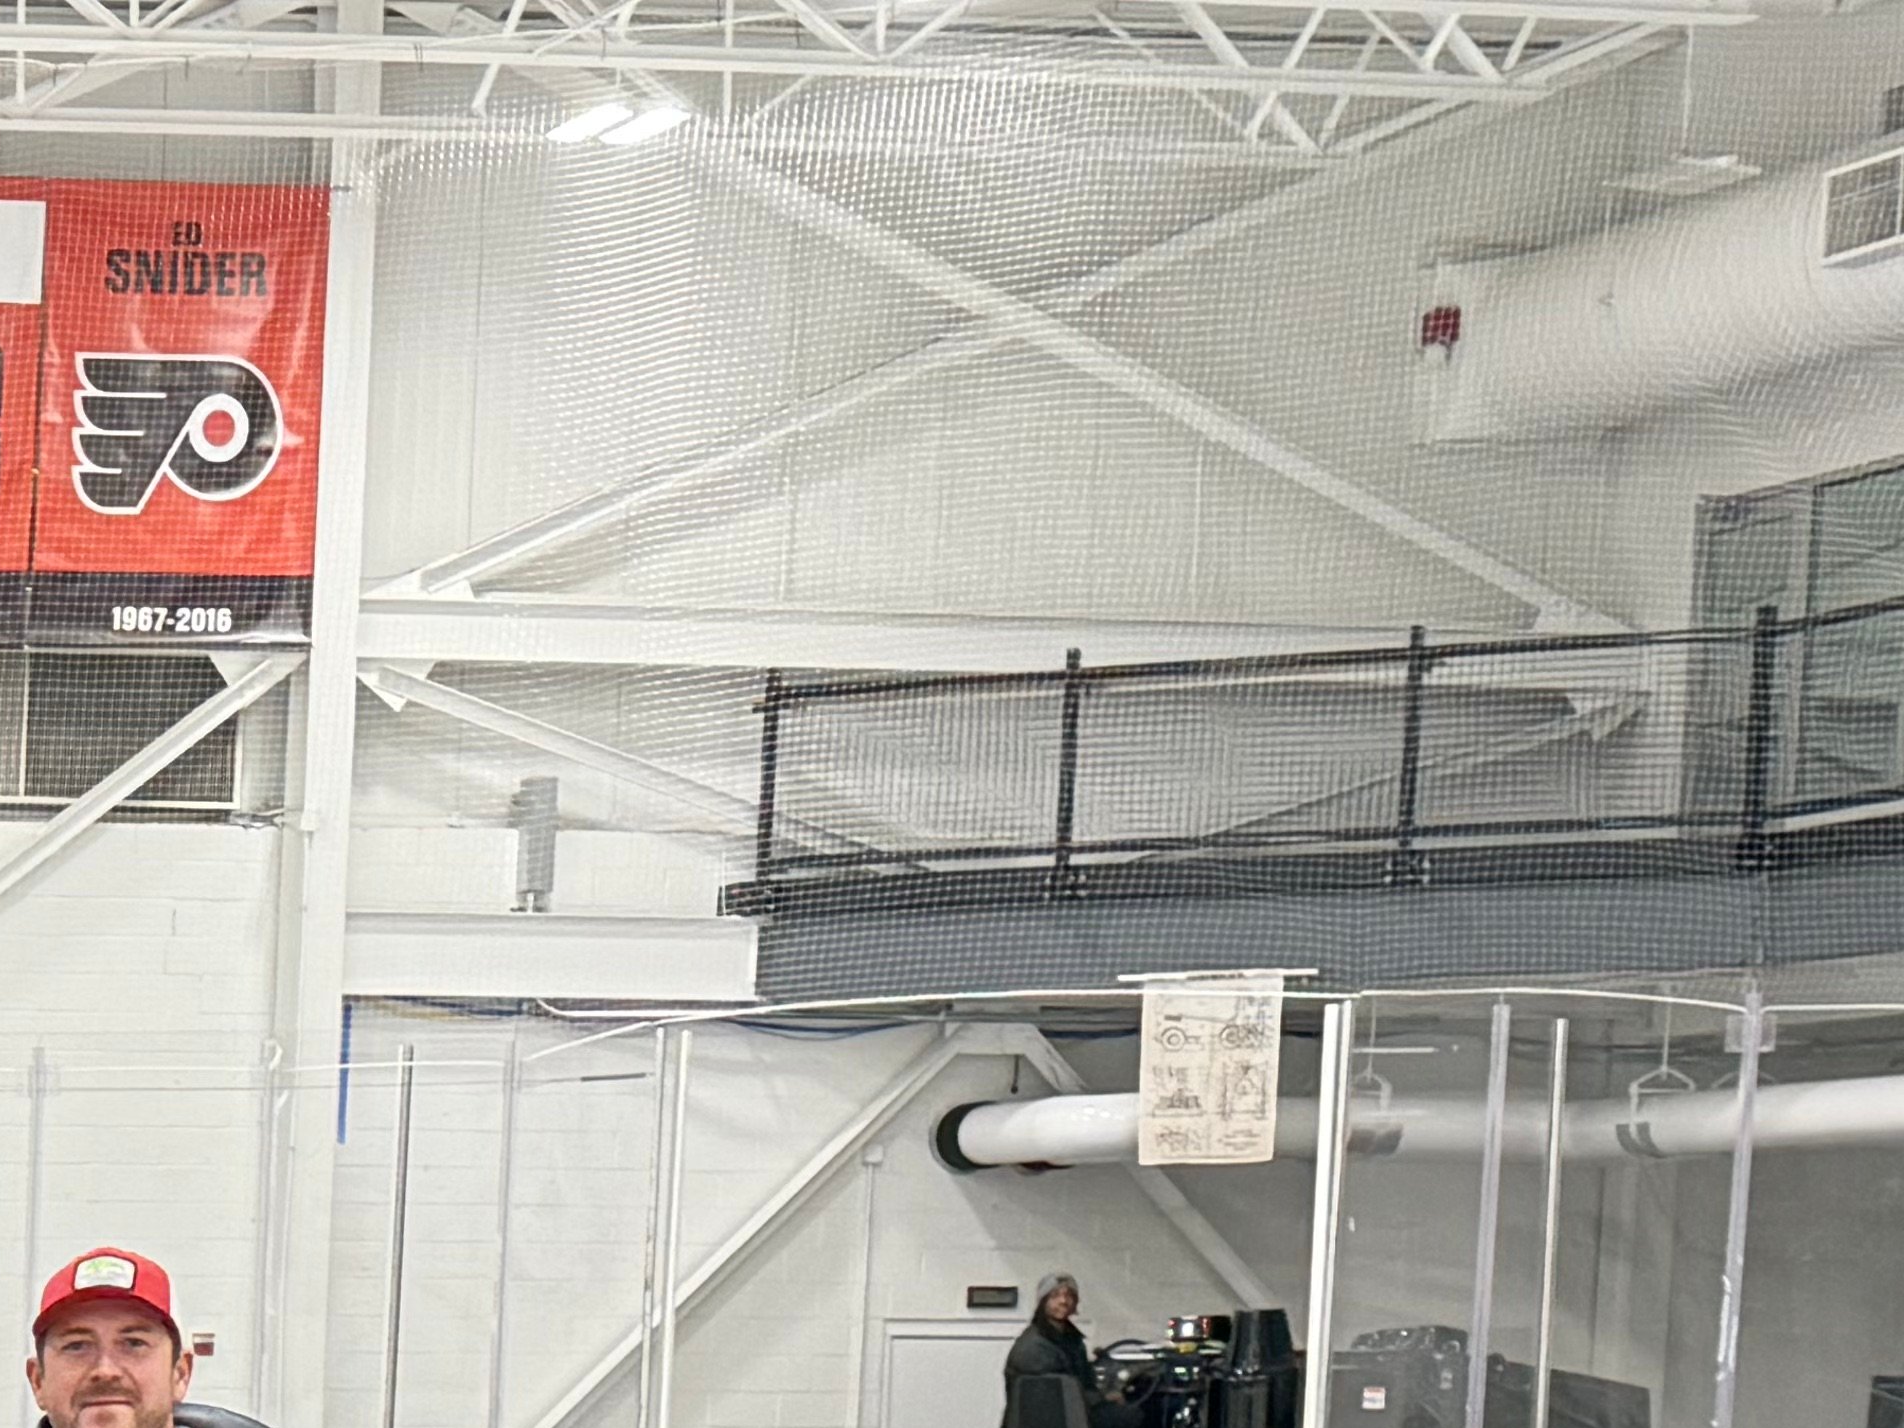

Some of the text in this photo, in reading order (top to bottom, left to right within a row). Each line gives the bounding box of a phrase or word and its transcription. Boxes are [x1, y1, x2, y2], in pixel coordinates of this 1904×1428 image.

[171, 221, 203, 246] ED
[104, 248, 268, 298] SNIDER
[111, 605, 233, 633] 1967-2016
